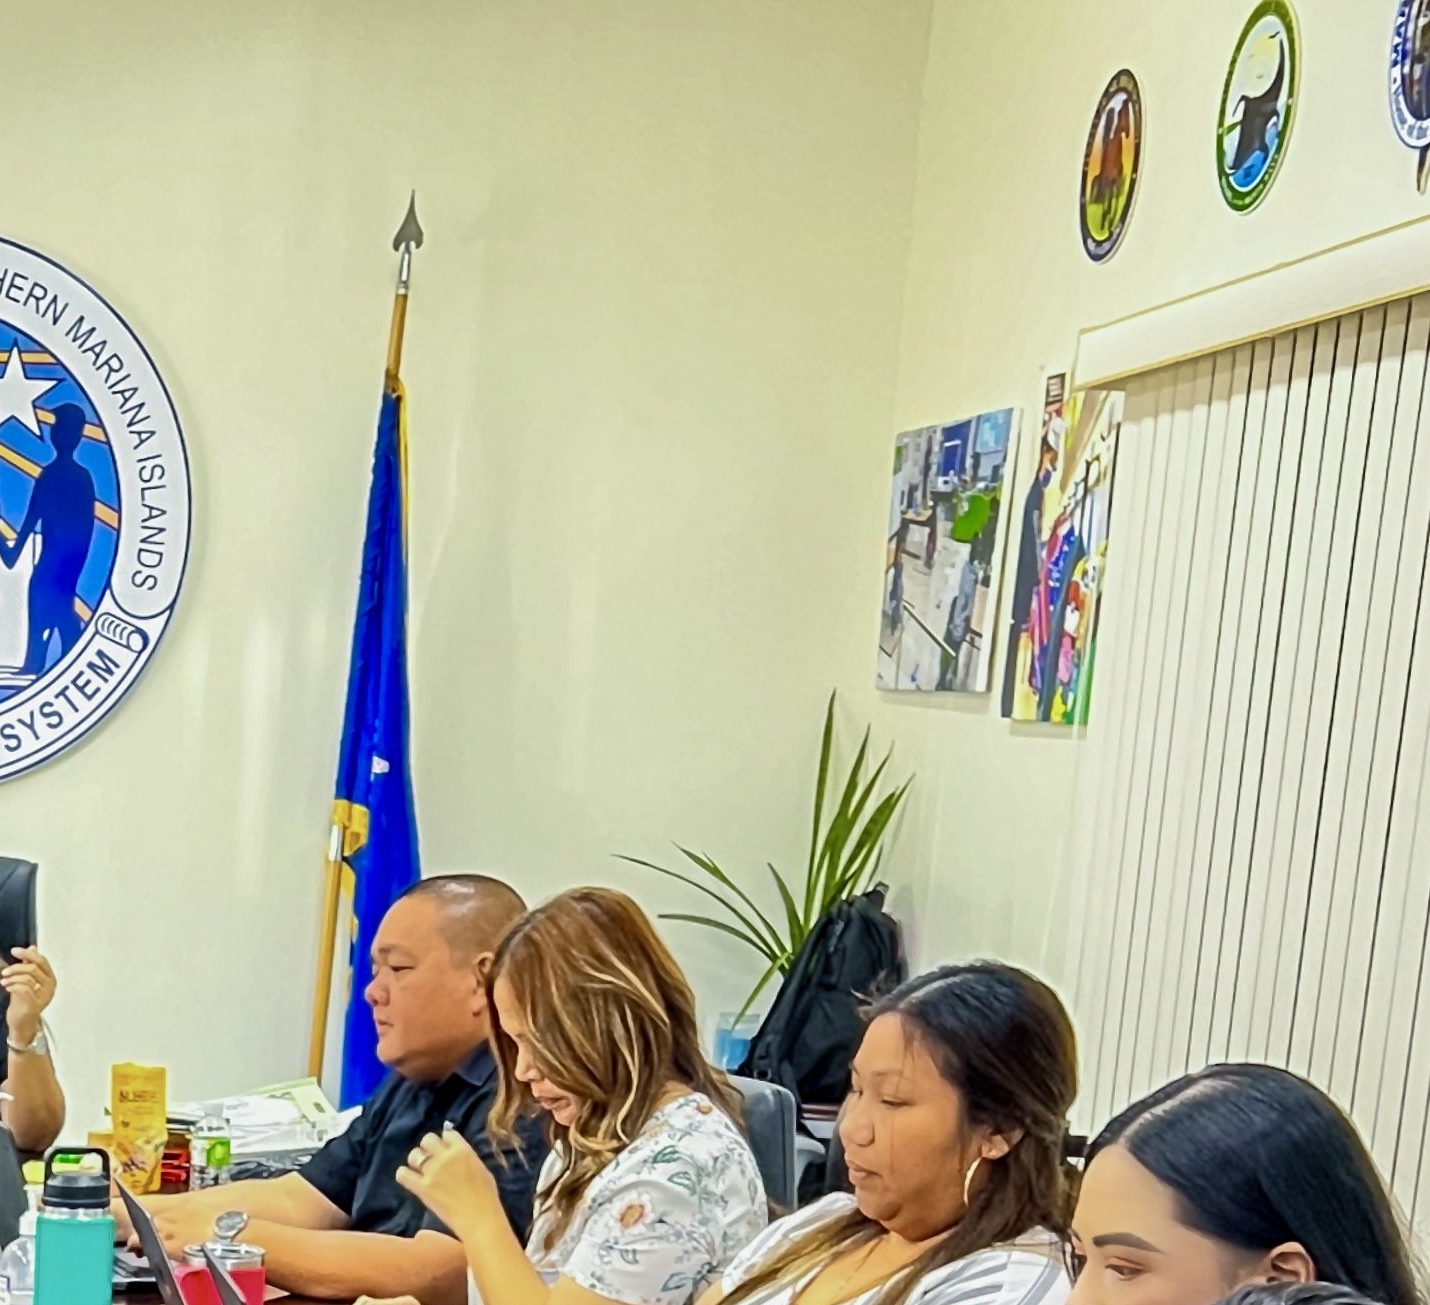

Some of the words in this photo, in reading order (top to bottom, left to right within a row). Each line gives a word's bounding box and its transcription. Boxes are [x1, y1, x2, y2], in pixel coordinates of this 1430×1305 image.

[63, 314, 156, 449] MARIANA
[131, 452, 168, 592] ISLANDS
[0, 651, 121, 753] SYSTEM
